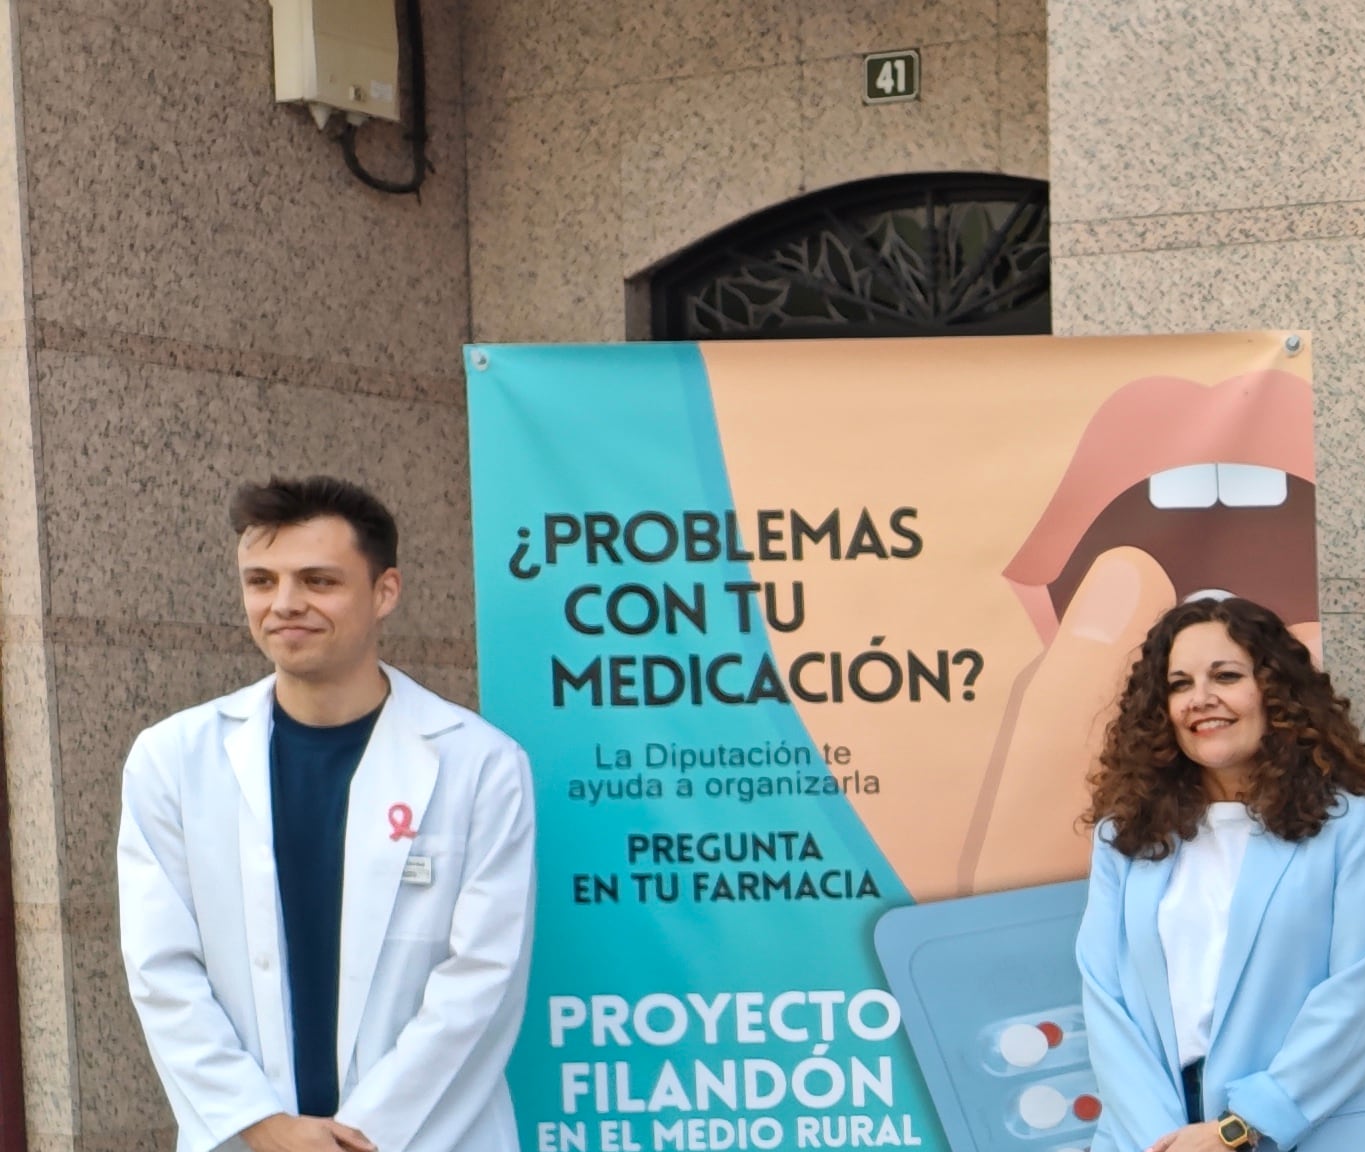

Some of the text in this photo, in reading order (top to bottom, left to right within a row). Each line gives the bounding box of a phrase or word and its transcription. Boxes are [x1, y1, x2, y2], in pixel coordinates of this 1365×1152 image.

[876, 59, 906, 94] 41
[508, 506, 924, 579] ¿PROBLEMAS
[564, 580, 806, 635] CON TU
[551, 636, 985, 707] MEDICACIÓN?
[595, 740, 852, 774] La Diputación te
[568, 769, 881, 807] ayuda a organizarla
[627, 831, 824, 864] PREGUNTA
[572, 869, 881, 905] EN TU FARMACIA
[549, 988, 902, 1048] PROYECTO
[561, 1043, 894, 1115] FILANDÓN
[653, 1116, 784, 1152] MEDIO
[797, 1114, 923, 1149] RURAL
